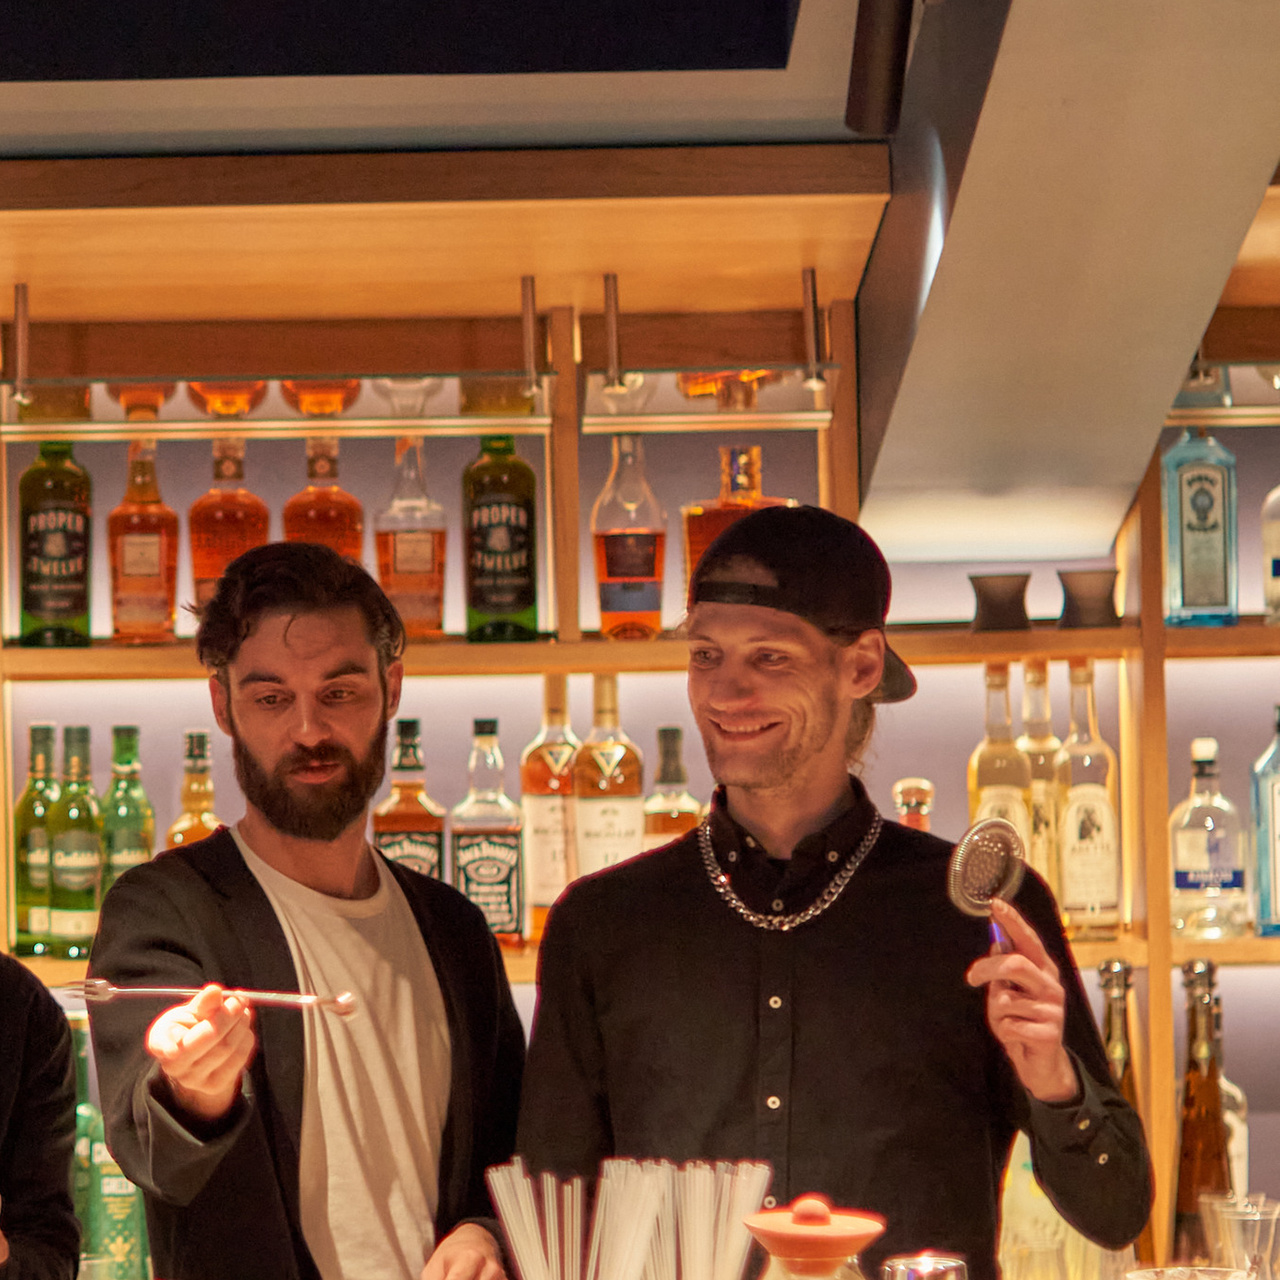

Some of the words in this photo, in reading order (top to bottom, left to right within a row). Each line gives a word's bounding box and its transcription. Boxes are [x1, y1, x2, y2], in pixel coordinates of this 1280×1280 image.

[29, 512, 84, 533] PROPER
[473, 505, 527, 528] PROPER
[32, 556, 83, 576] TWELVE
[476, 551, 527, 571] TWELVE
